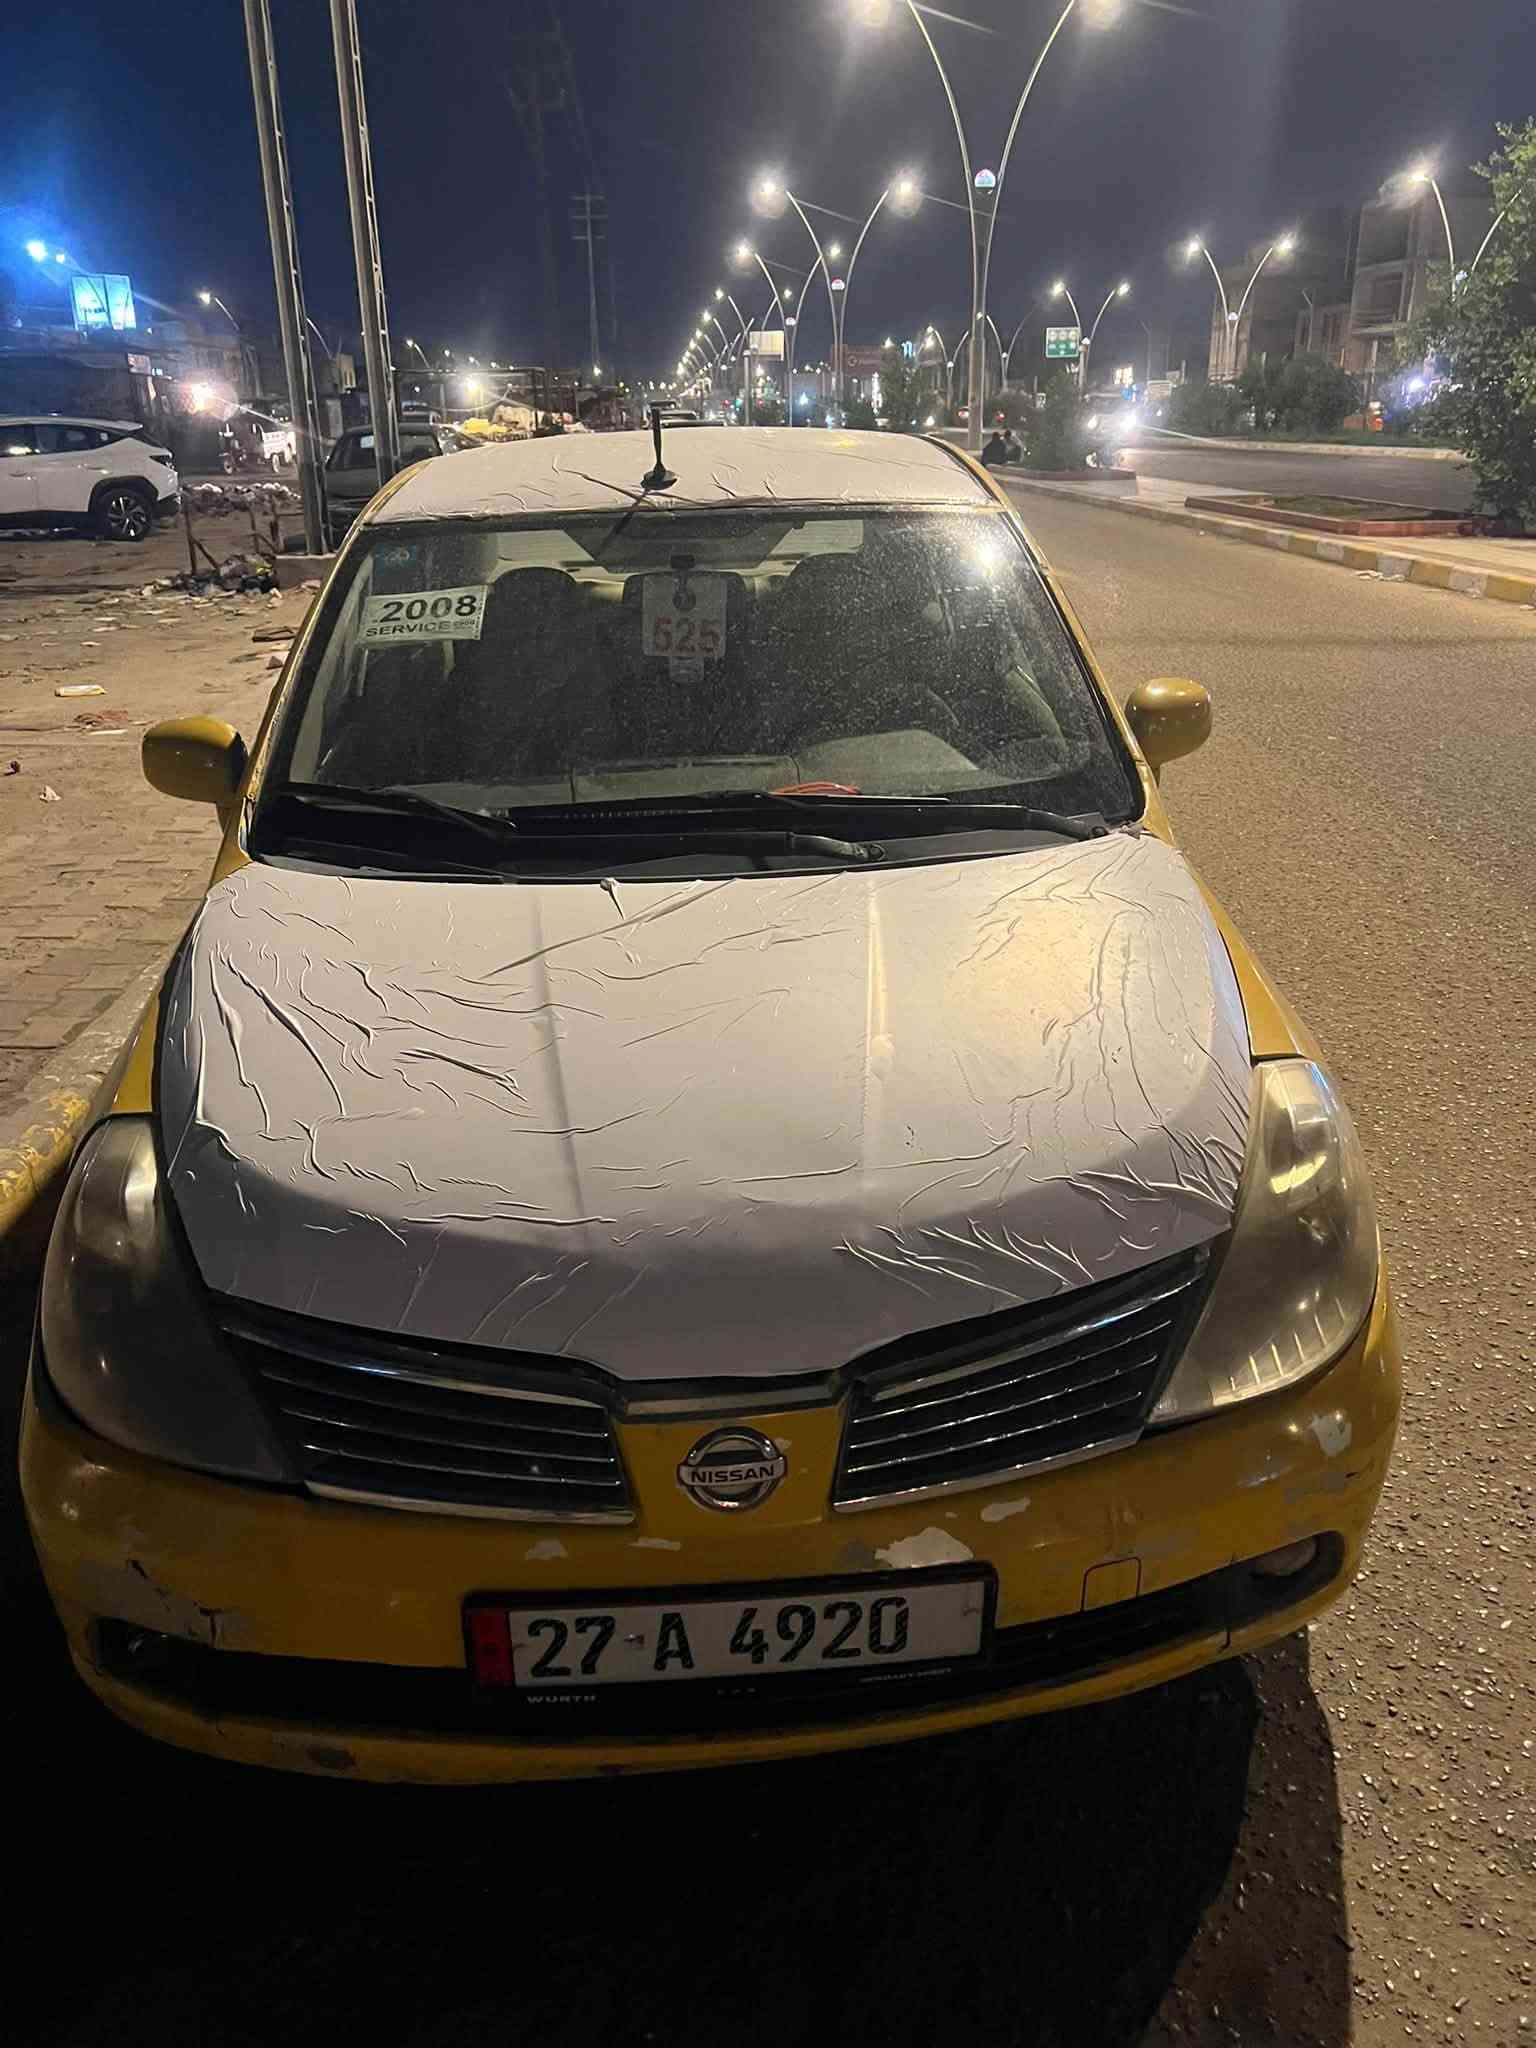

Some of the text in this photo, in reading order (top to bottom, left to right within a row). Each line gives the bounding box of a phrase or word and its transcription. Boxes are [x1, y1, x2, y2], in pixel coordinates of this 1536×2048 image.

[380, 595, 477, 623] 2008
[366, 620, 453, 637] SERVICE
[690, 1464, 775, 1483] NISSAN
[527, 1597, 909, 1678] 27 A 4920
